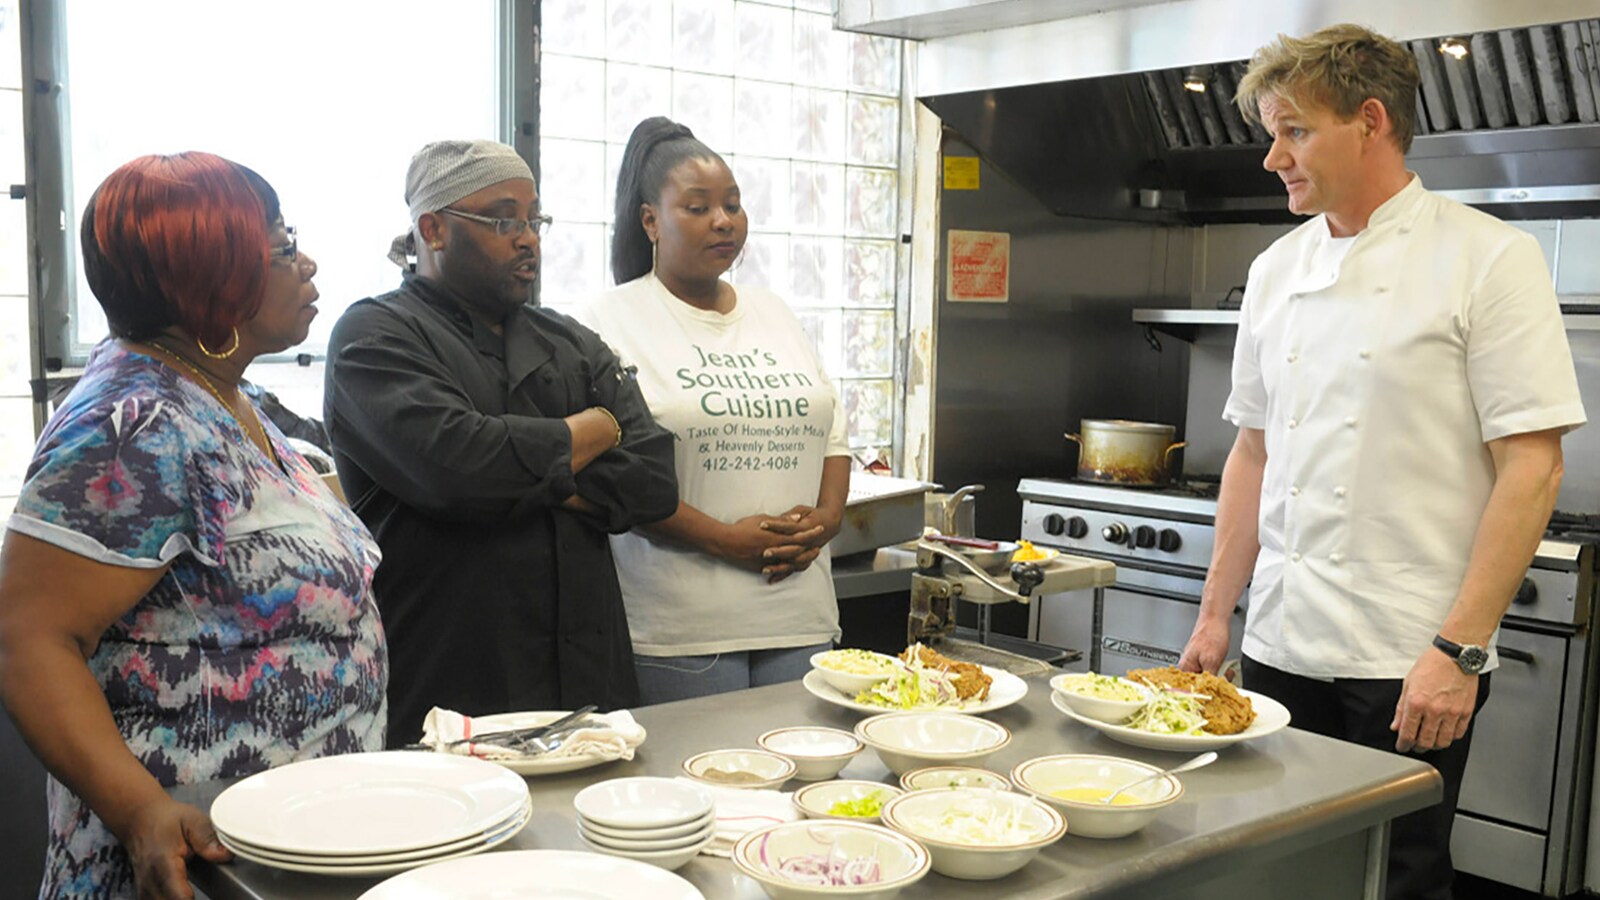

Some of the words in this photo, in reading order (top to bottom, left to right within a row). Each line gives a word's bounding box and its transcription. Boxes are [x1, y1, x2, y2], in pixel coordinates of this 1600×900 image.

[692, 344, 777, 368] Jean's
[676, 368, 813, 390] Southern
[701, 391, 809, 419] Cuisine
[687, 424, 720, 439] Taste
[723, 423, 738, 436] Of
[742, 424, 801, 438] Home-Style
[716, 440, 763, 453] Heavenly
[768, 441, 805, 452] Desserts
[703, 457, 798, 471] 412-242-4084
